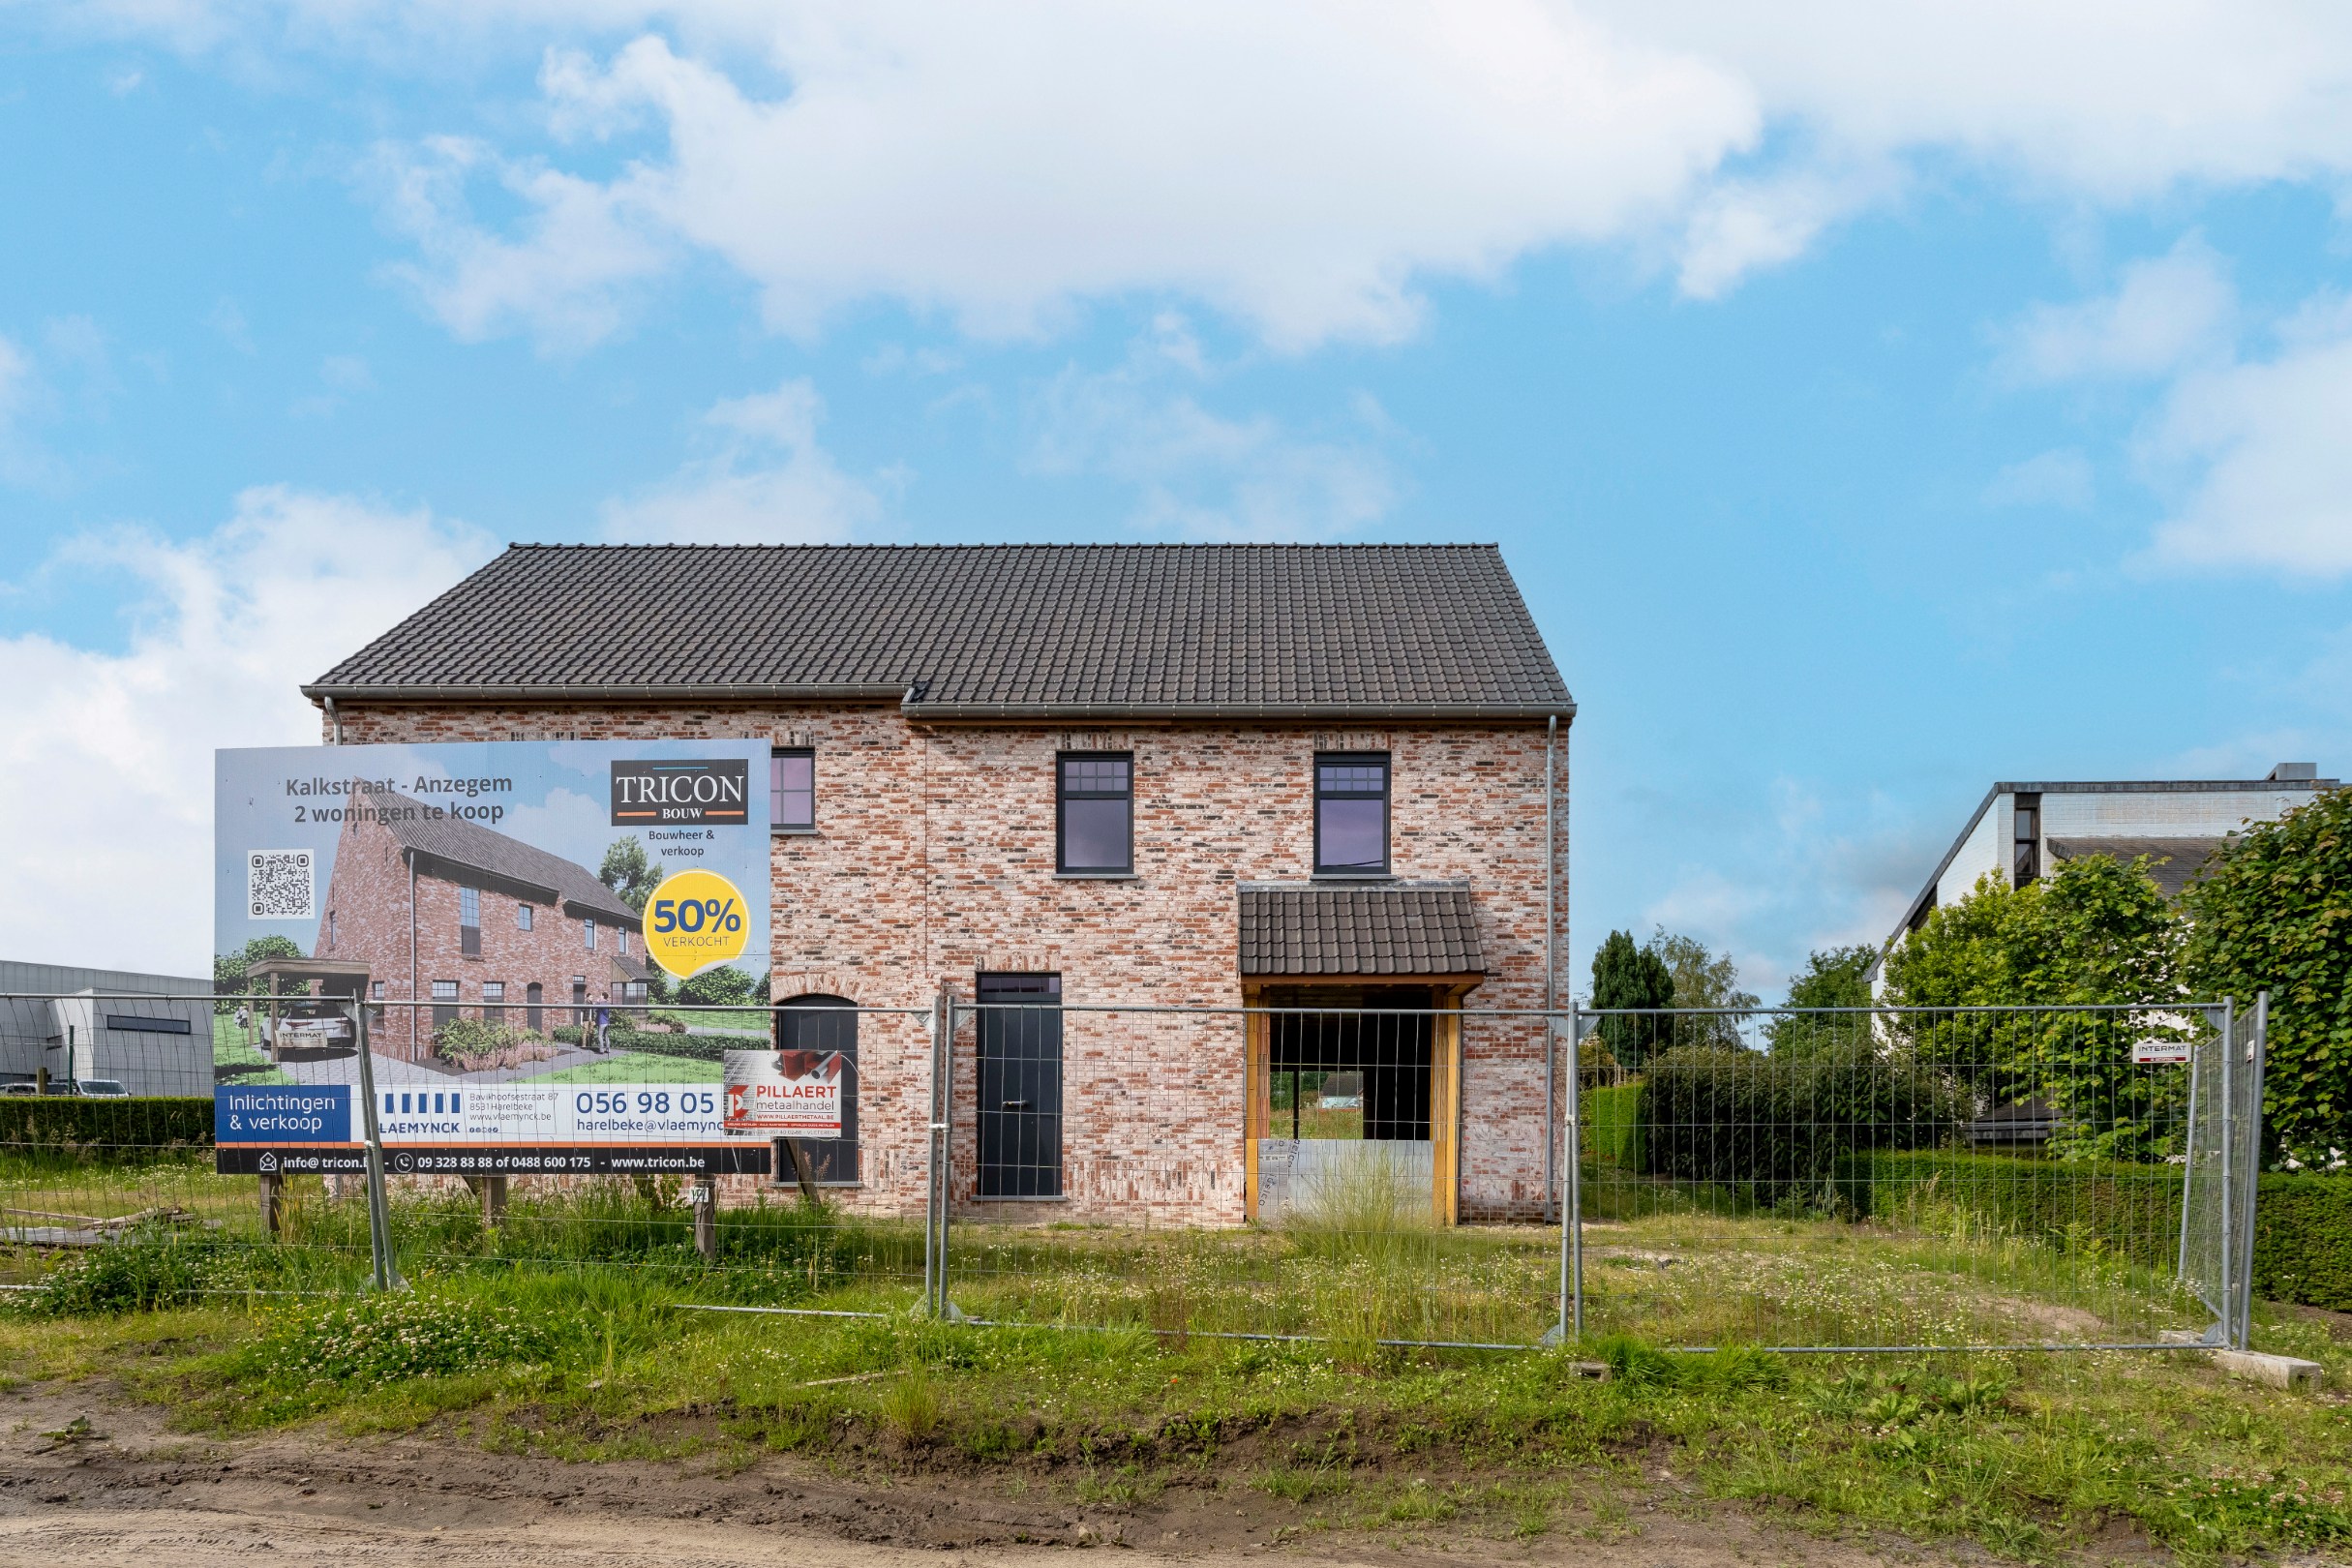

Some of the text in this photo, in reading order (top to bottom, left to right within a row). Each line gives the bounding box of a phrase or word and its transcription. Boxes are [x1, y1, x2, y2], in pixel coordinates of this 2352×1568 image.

[286, 776, 396, 797] Kalkstraat
[413, 775, 512, 798] Anzegem
[616, 775, 744, 803] TRICON
[294, 801, 504, 826] 2 woningen te koop
[662, 808, 703, 819] BOUW
[648, 829, 715, 840] Bouwheer &
[661, 846, 705, 858] verkoop
[654, 898, 741, 933] 50%
[663, 936, 731, 948] VERKOCHT
[548, 1092, 558, 1101] 87
[756, 1085, 837, 1099] PILLAERT
[229, 1095, 335, 1114] Inlichtingen
[492, 1102, 533, 1111] Harelbeke
[576, 1092, 714, 1114] 056 98 05
[756, 1101, 834, 1110] metaalhandel
[229, 1113, 322, 1133] & verkoop
[469, 1112, 552, 1122] www.vlaemynck.be
[379, 1122, 460, 1133] LAEMYNCK
[577, 1118, 724, 1133] harelbeke@vlaemync
[322, 1157, 368, 1167] tricon.b
[417, 1157, 433, 1168] 09
[436, 1157, 458, 1168] 328
[460, 1157, 475, 1168] 88
[477, 1157, 493, 1168] 88
[496, 1157, 509, 1168] of
[511, 1157, 541, 1168] 0488
[544, 1157, 566, 1168] 600
[569, 1157, 591, 1168] 175
[611, 1157, 706, 1168] www.tricon.be
